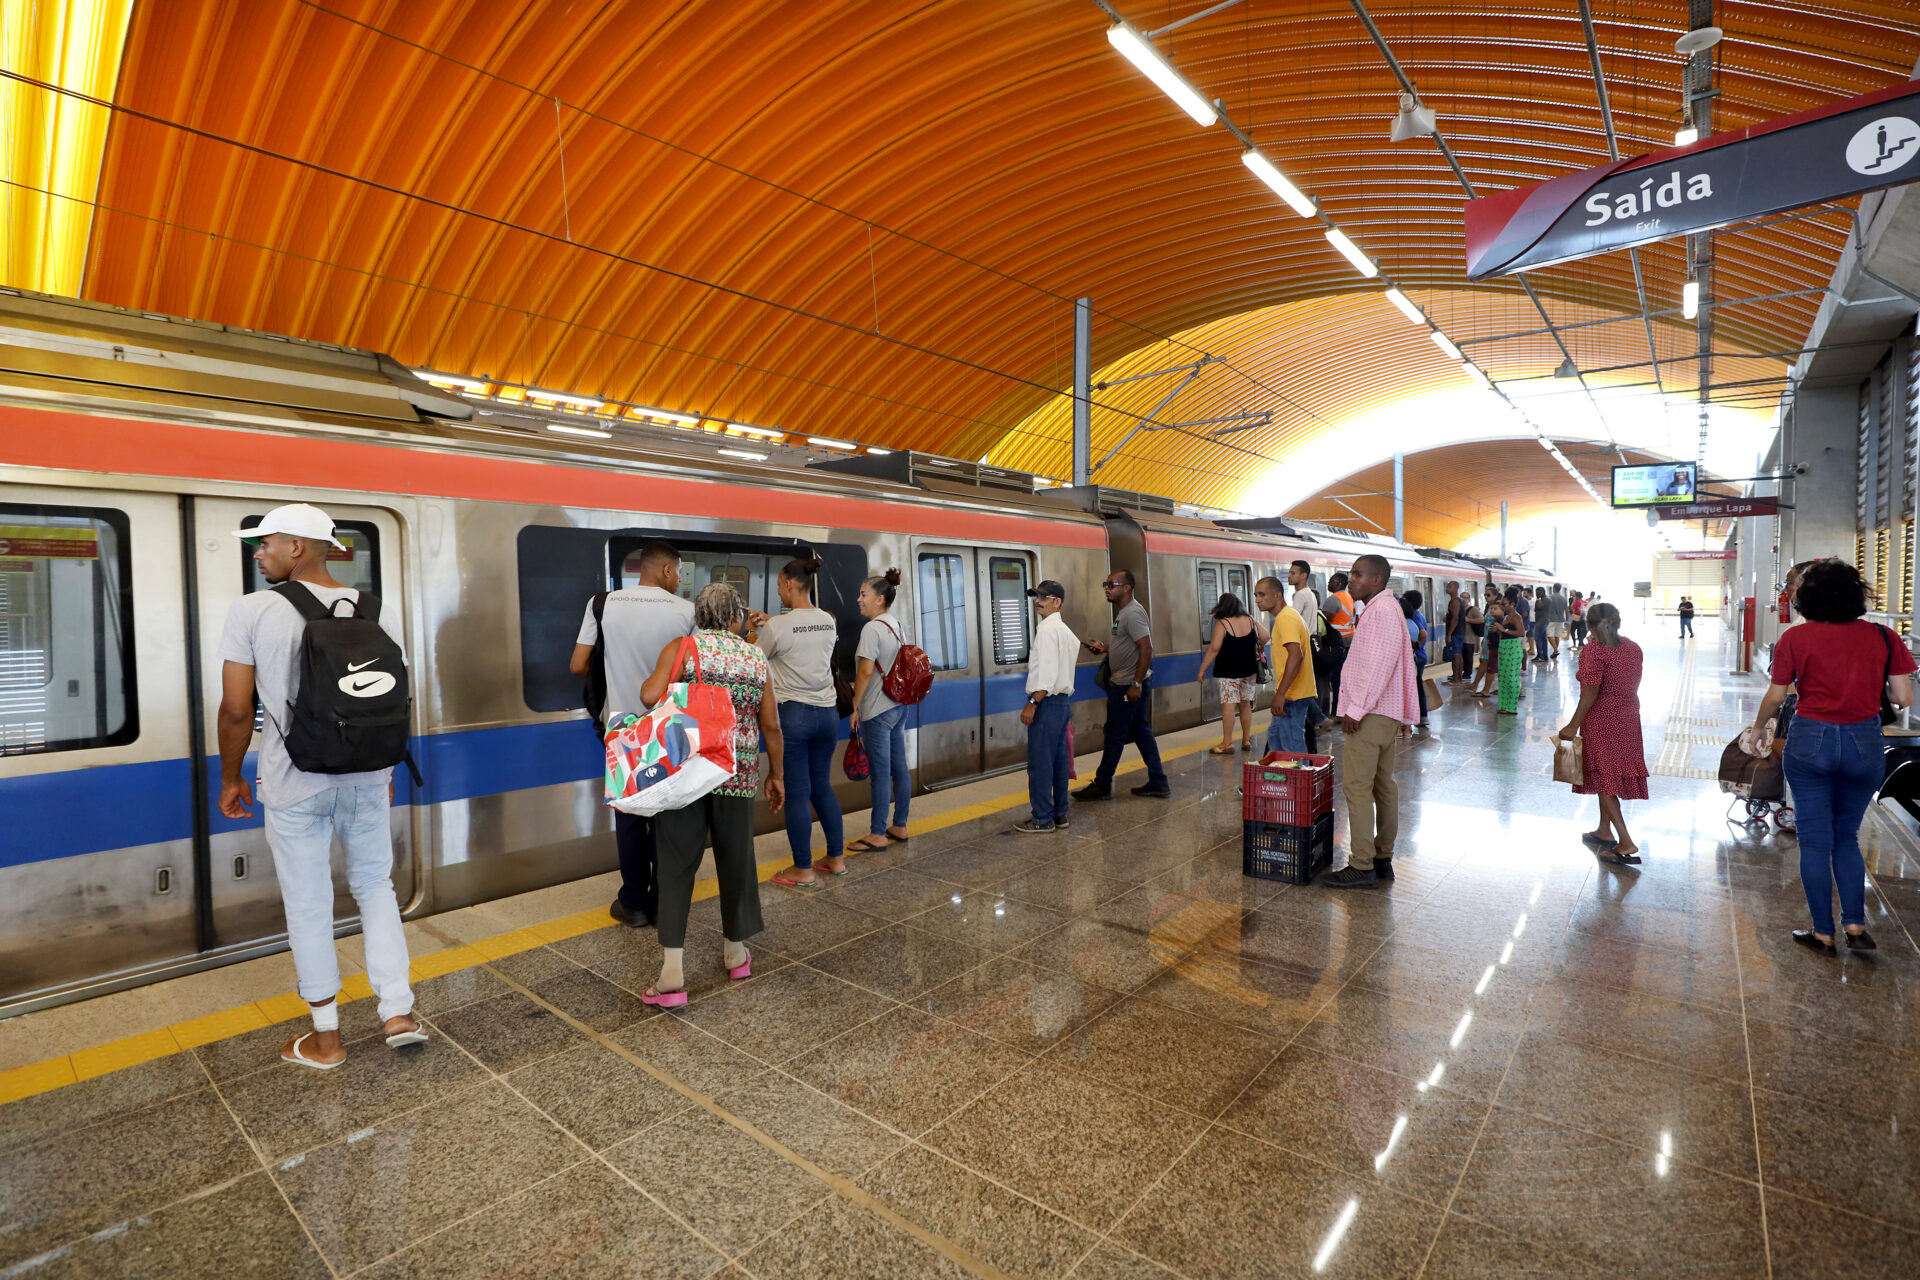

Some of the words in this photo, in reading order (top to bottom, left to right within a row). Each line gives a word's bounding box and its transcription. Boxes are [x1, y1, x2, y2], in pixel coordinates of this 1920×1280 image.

[1585, 171, 1713, 227] Saída
[1635, 218, 1661, 232] Exit
[1671, 505, 1722, 515] Embarque
[1726, 504, 1752, 513] Lapa
[792, 626, 807, 634] APOIO
